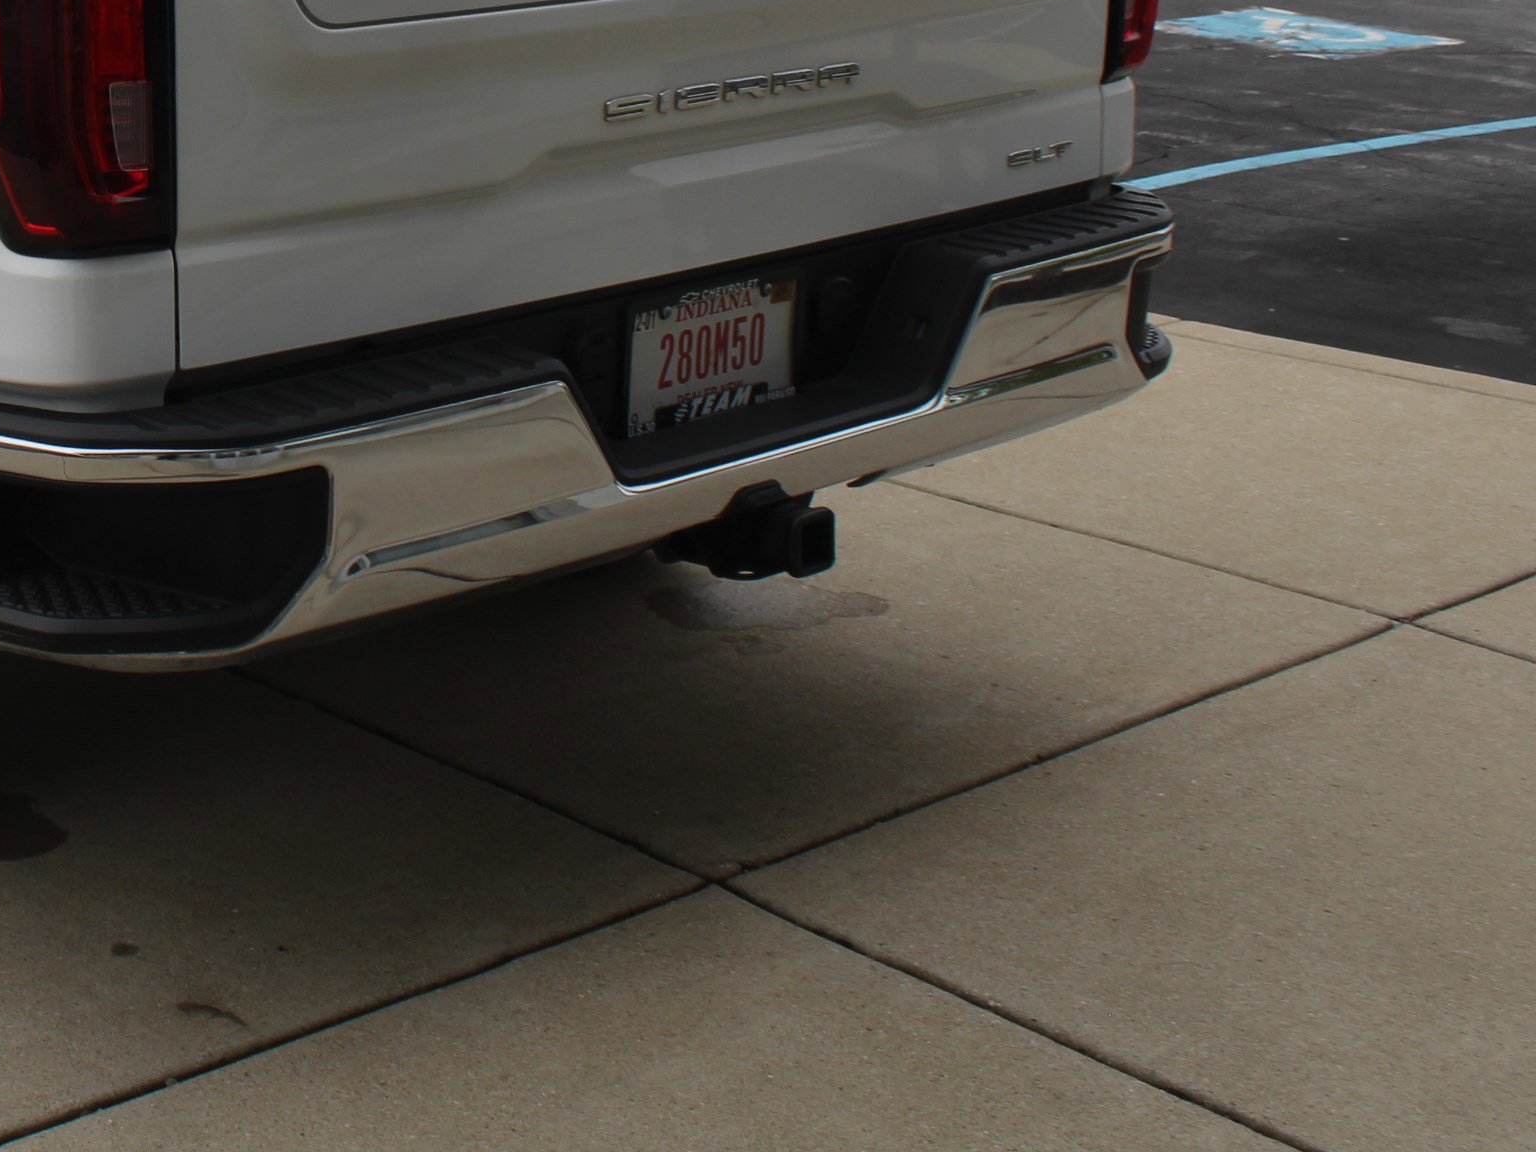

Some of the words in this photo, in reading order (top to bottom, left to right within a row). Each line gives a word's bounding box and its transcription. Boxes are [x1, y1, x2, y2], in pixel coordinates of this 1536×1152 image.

[604, 62, 860, 122] SIERRA
[1006, 139, 1075, 168] SLT
[675, 289, 753, 323] INDIANA
[702, 278, 760, 301] CHEVROLET
[658, 312, 766, 390] 280M50
[689, 385, 753, 420] TEAM
